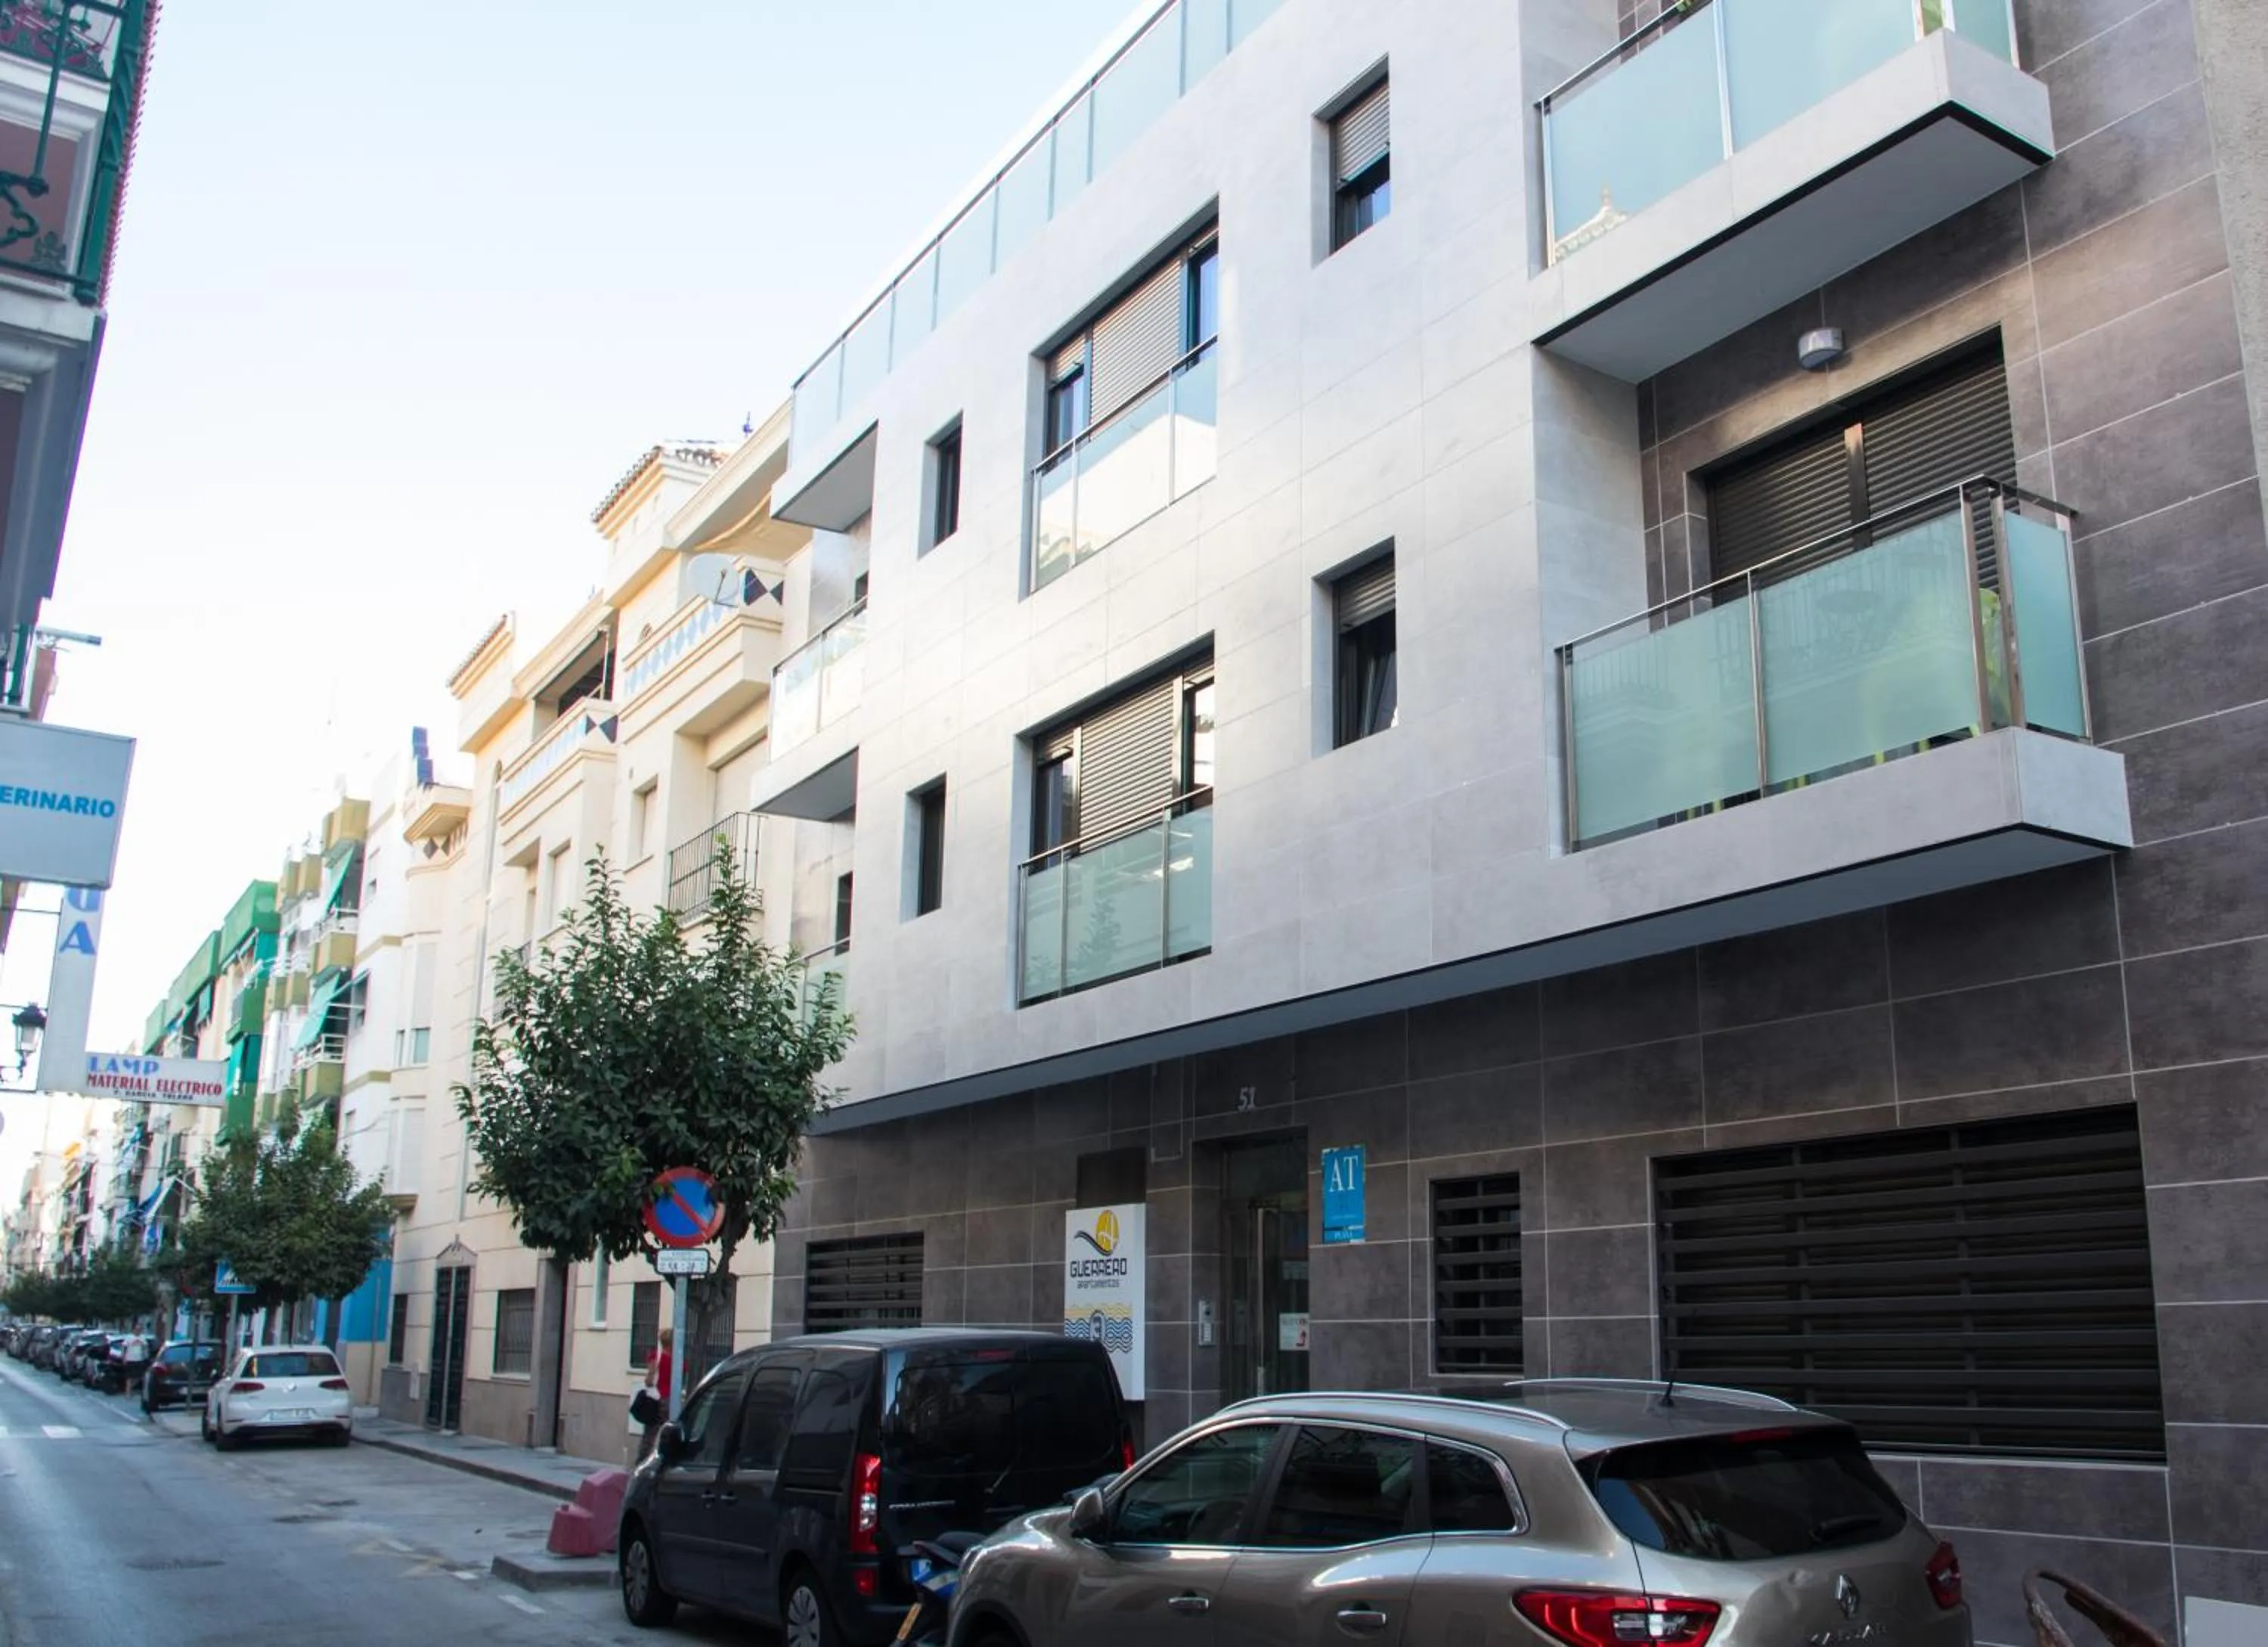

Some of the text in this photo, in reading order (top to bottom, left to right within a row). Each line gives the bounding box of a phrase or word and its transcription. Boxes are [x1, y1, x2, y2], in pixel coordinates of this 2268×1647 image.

[87, 1074, 222, 1095] MATERIAL ELECTRICO
[1238, 1087, 1256, 1111] 51
[1329, 1155, 1359, 1193] AT
[1070, 1258, 1127, 1278] GUERRERO
